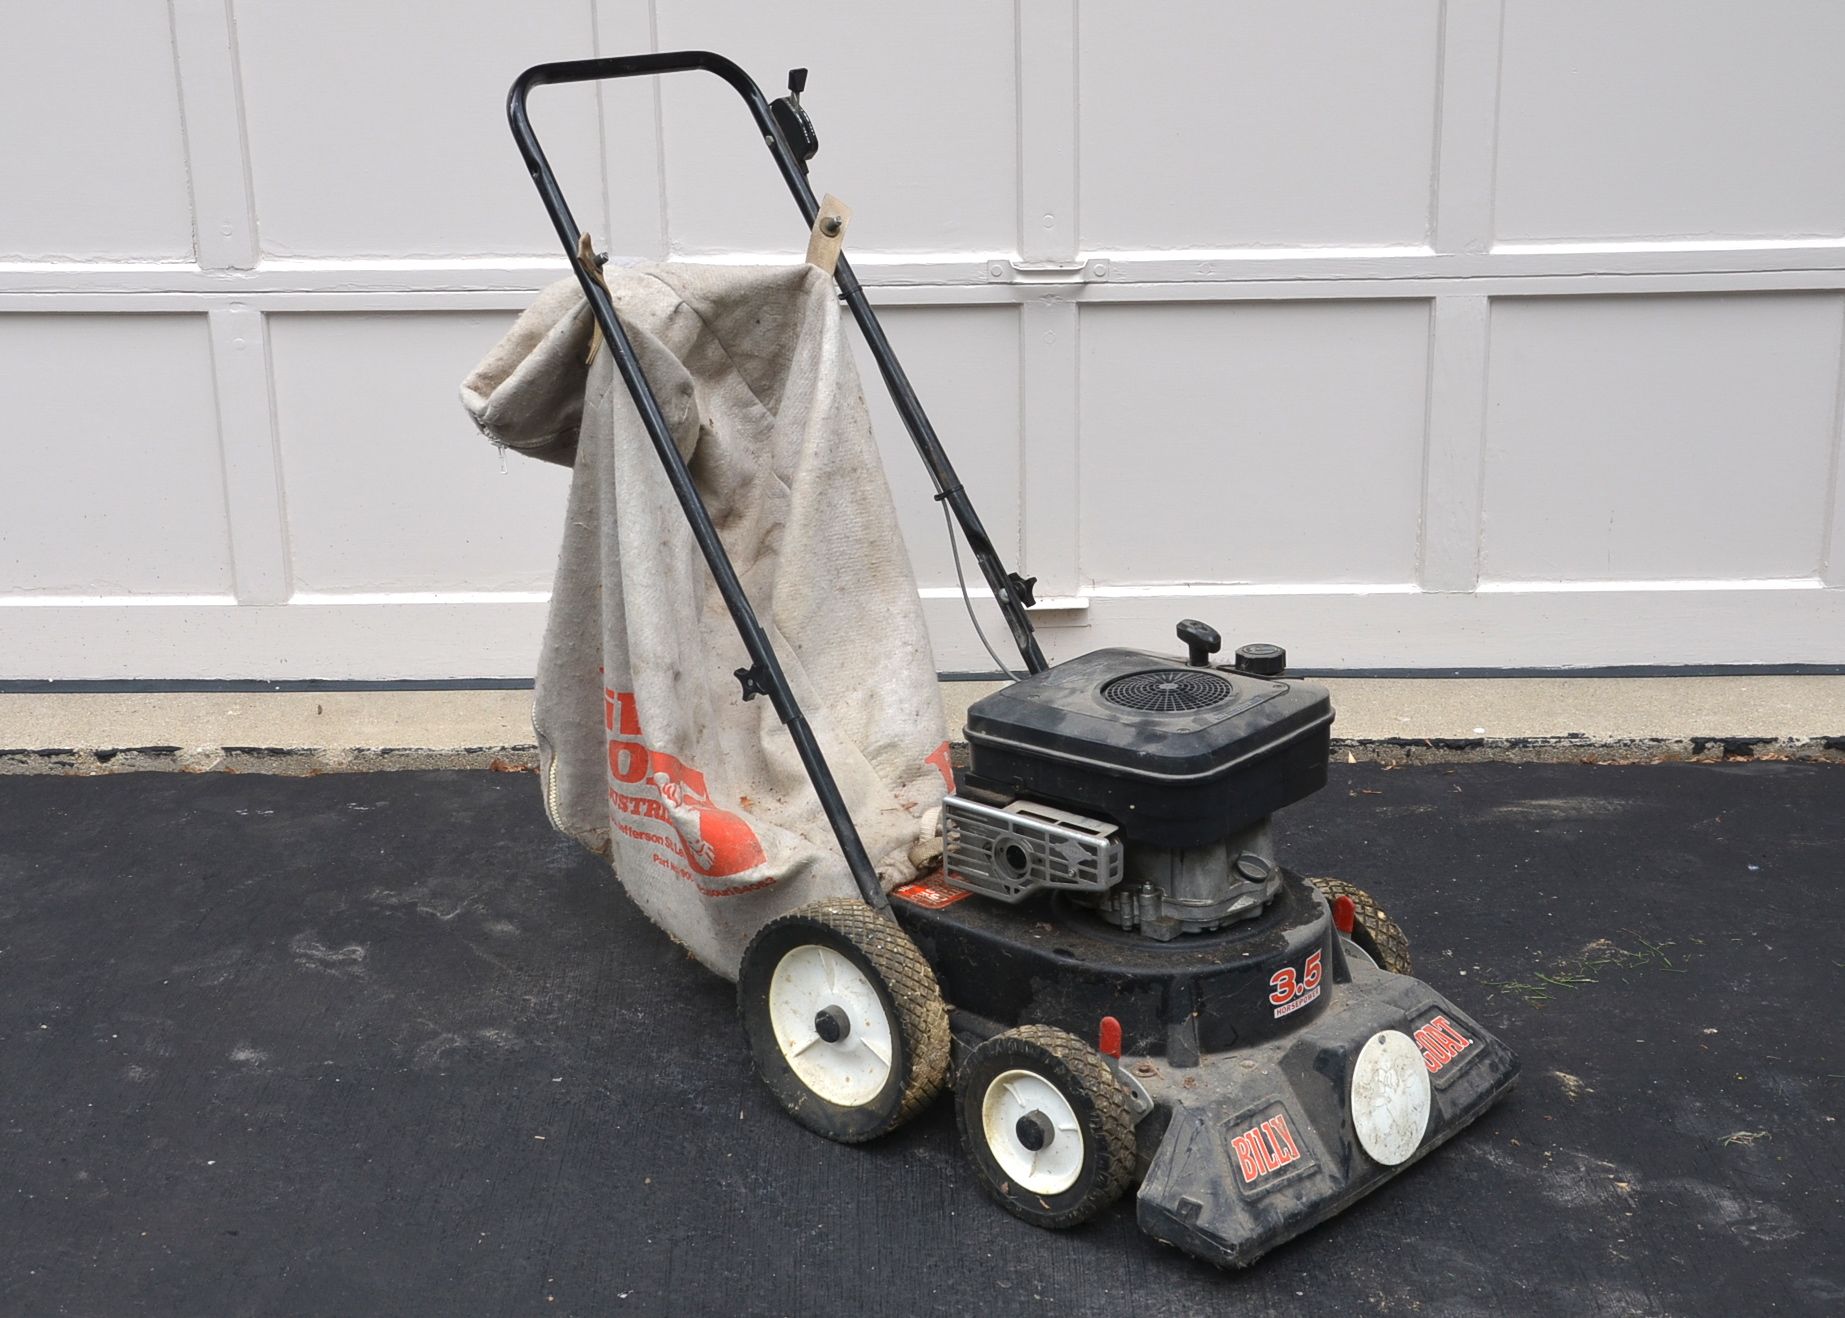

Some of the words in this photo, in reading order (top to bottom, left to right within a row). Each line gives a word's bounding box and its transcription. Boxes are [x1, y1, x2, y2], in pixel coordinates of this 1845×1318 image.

[1269, 949, 1322, 1005] 3.5
[1275, 987, 1320, 1017] HORSEPOWER
[1231, 1114, 1300, 1183] BILLY
